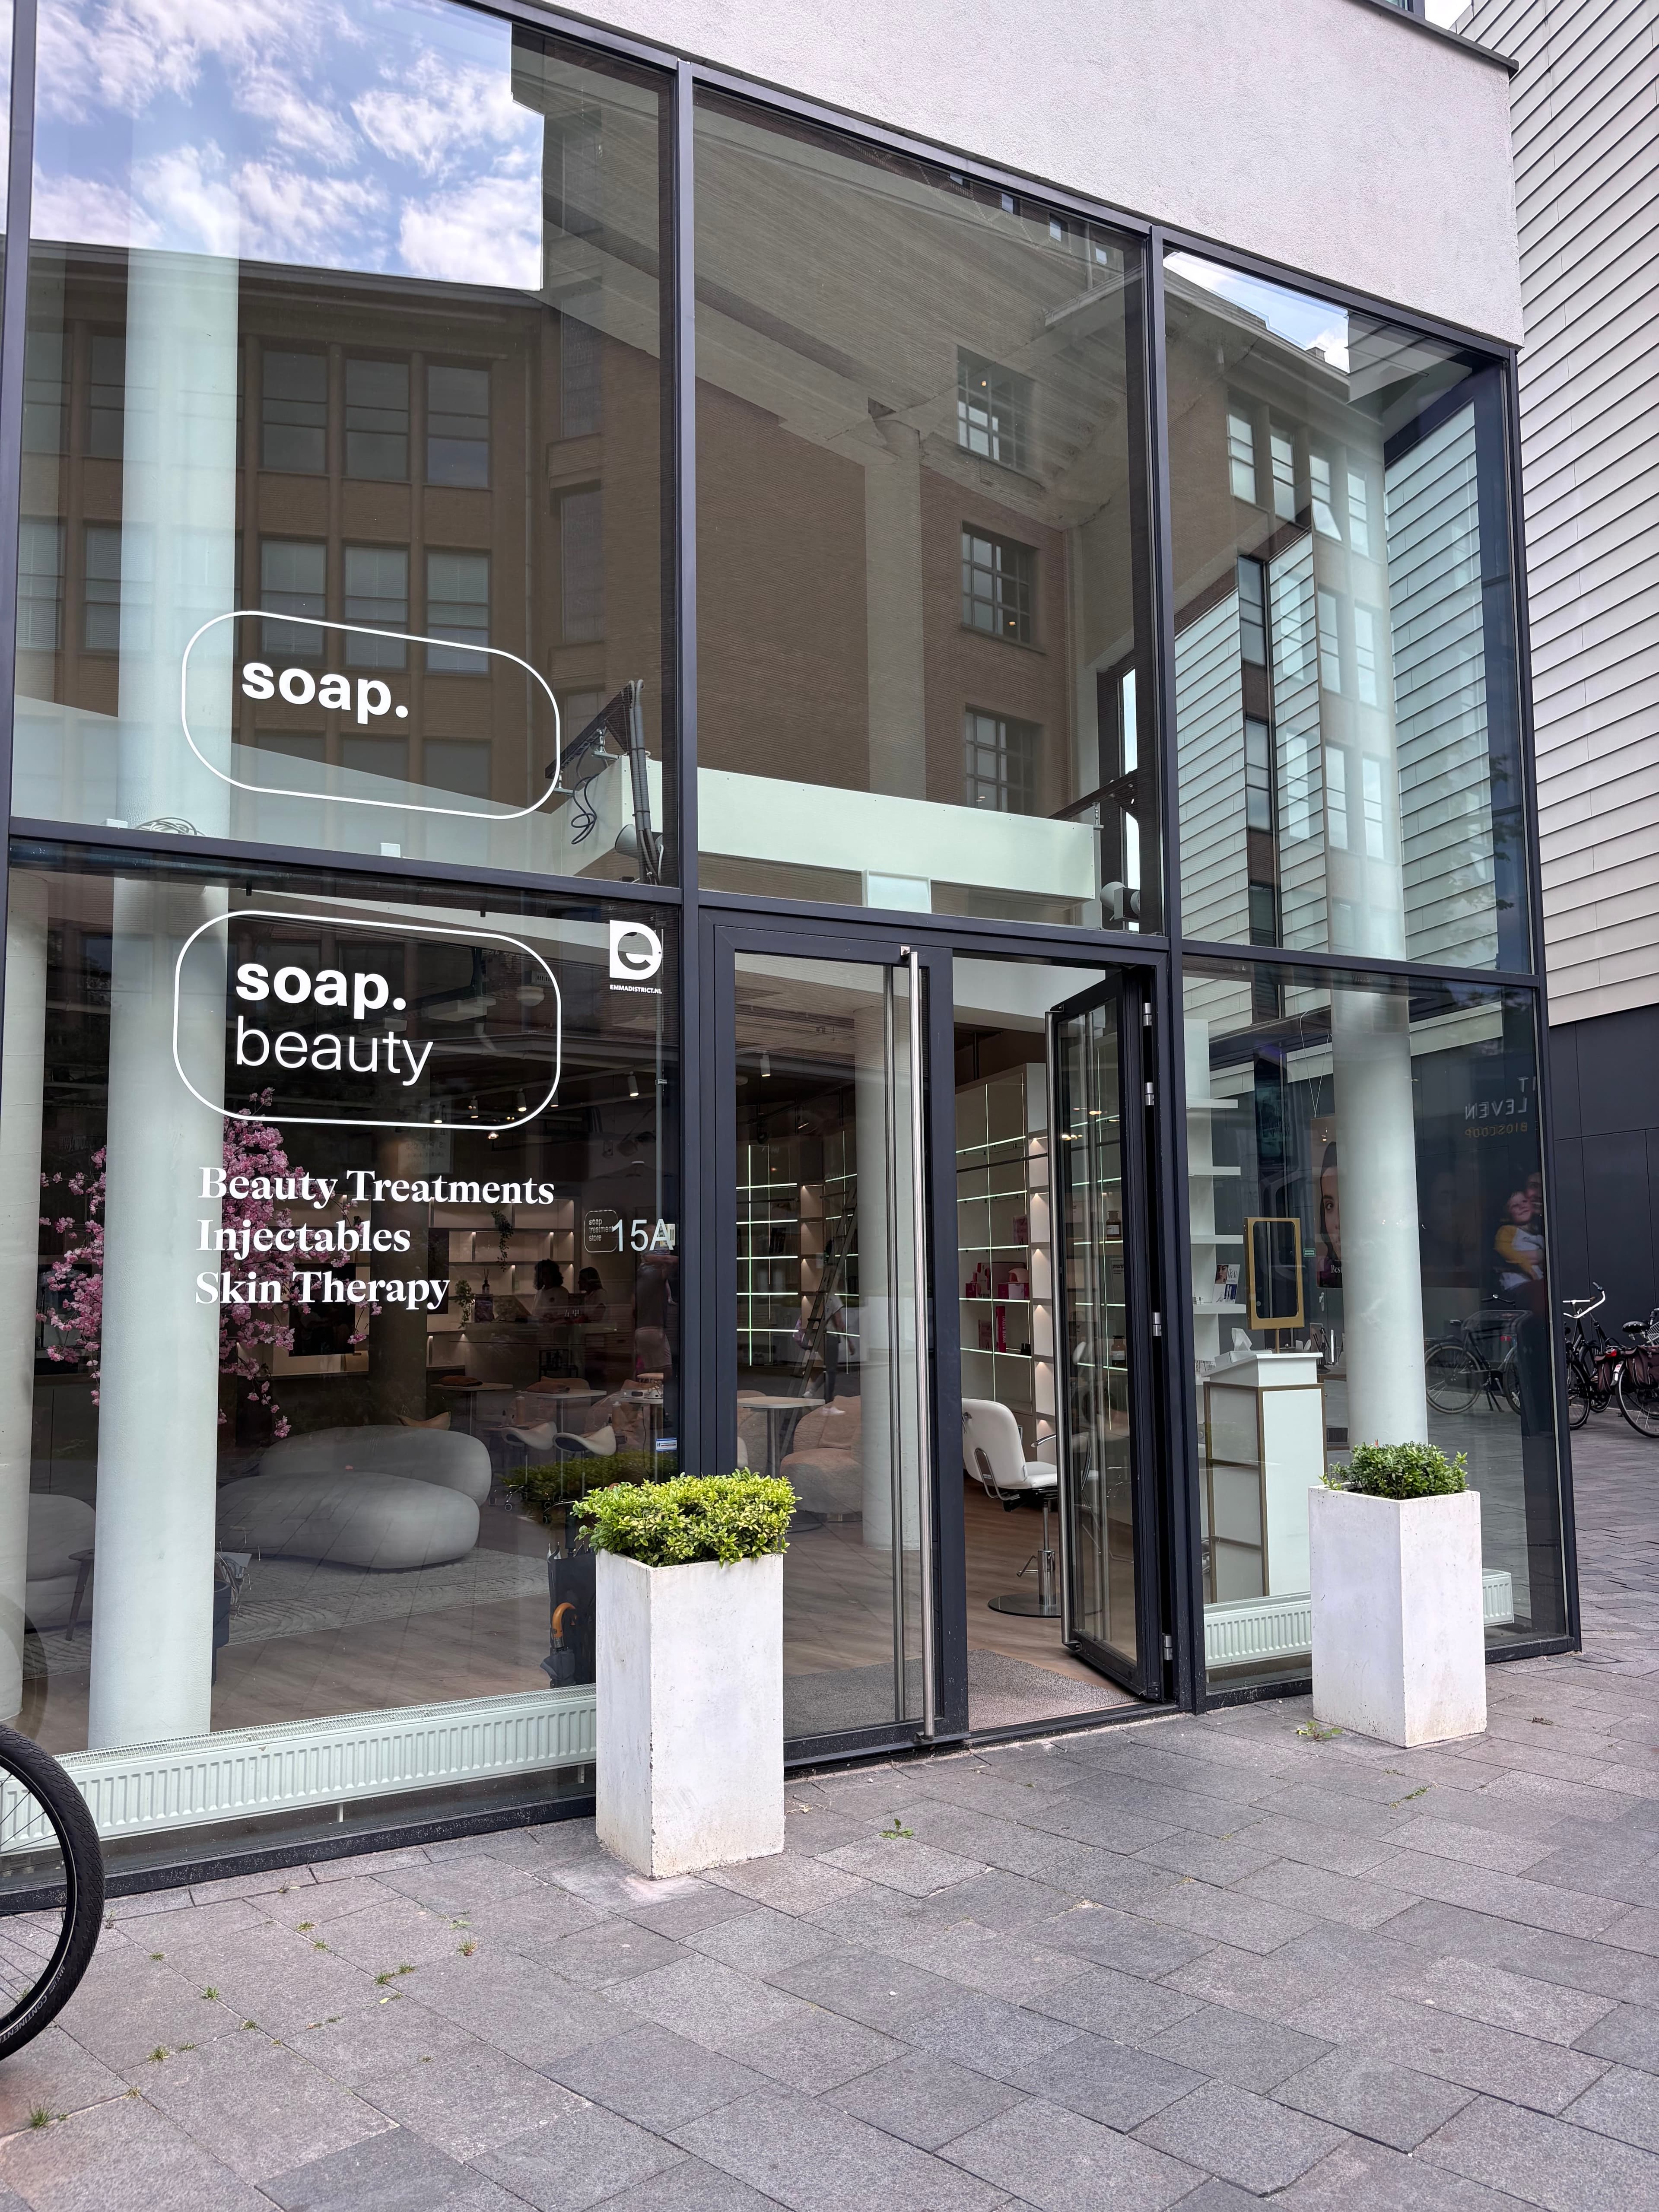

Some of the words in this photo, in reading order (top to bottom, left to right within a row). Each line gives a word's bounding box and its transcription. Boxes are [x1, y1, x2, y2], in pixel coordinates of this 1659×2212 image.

[242, 662, 409, 725] soap.
[236, 963, 406, 1020] soap.
[610, 984, 663, 994] EMMADISTRICT.NL
[236, 1015, 434, 1086] beauty
[197, 1166, 339, 1209] Beauty
[346, 1170, 554, 1205] Treatments
[195, 1219, 410, 1260] Injectables
[588, 1218, 602, 1227] soap
[612, 1218, 674, 1252] 15A
[195, 1271, 283, 1304] Skin
[292, 1271, 451, 1310] Therapy
[0, 1995, 48, 2043] CONTINENT
